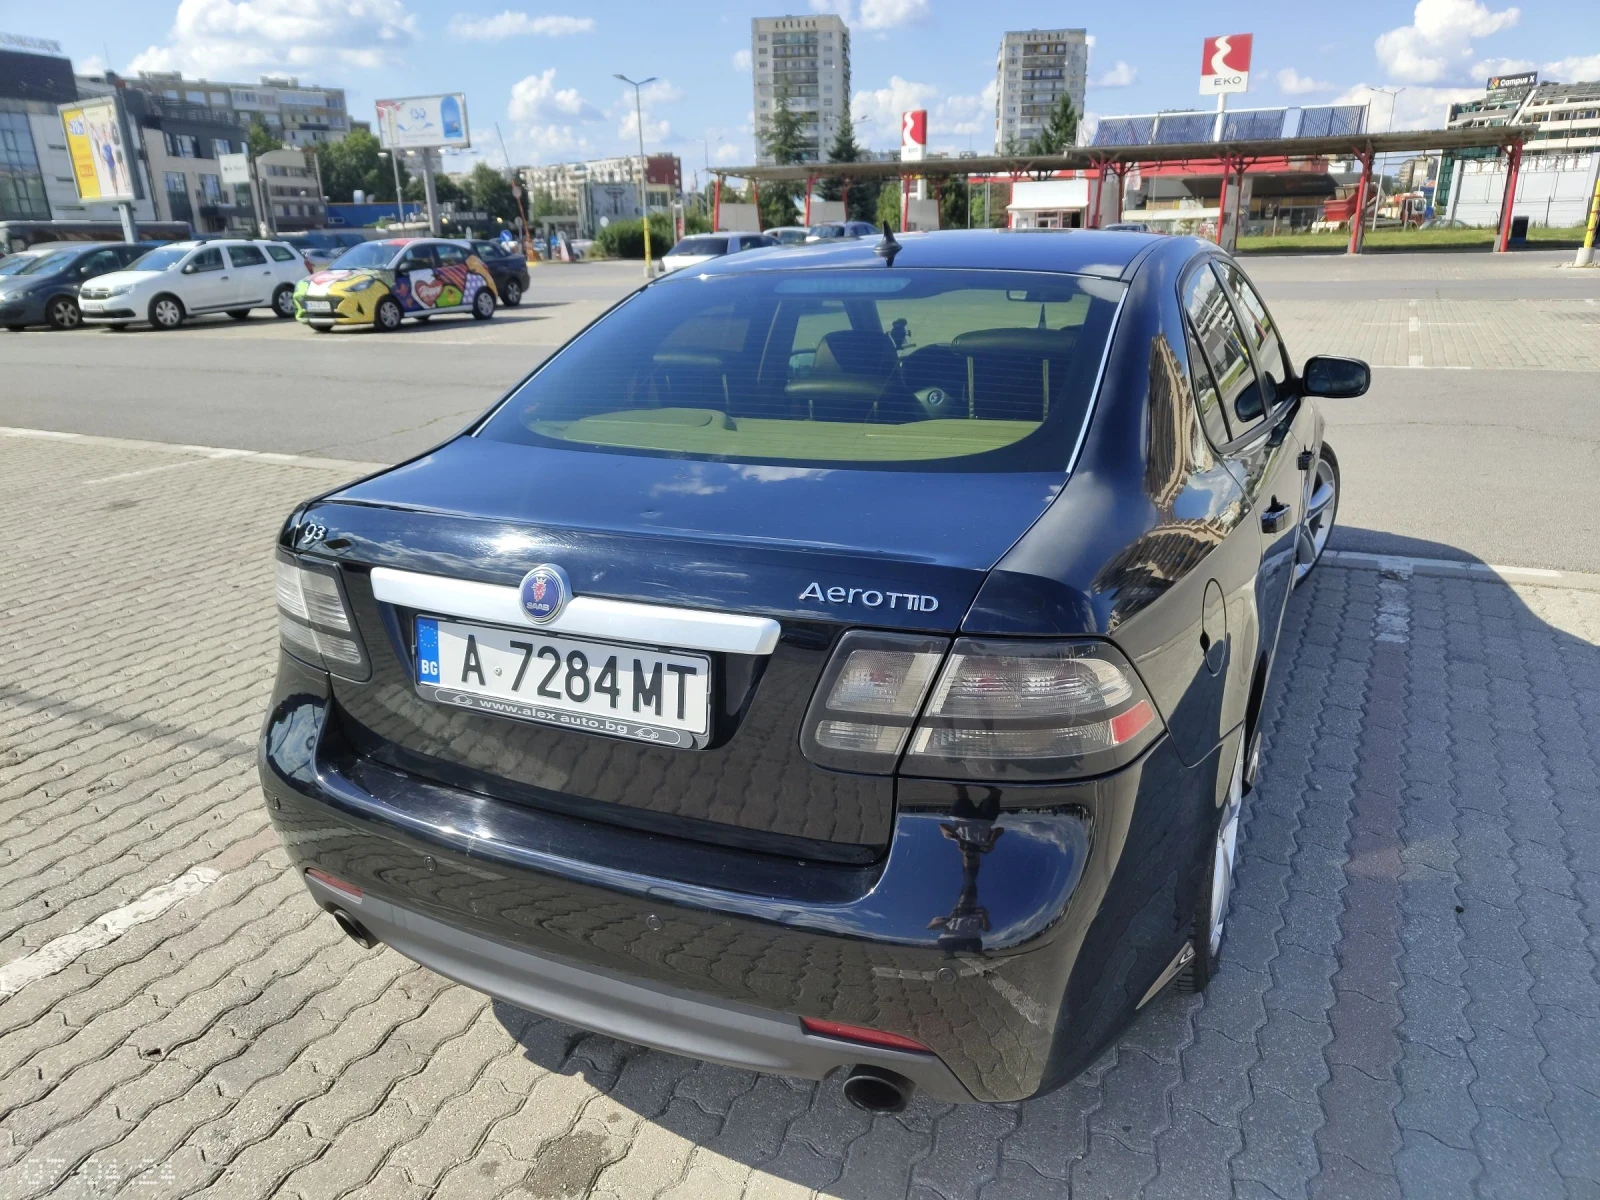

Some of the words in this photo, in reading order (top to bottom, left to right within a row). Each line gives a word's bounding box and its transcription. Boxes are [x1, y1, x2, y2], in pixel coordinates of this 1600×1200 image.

[1213, 75, 1242, 86] EKO
[1500, 77, 1529, 87] Campus
[1529, 75, 1535, 83] X
[302, 523, 327, 544] 93
[526, 601, 550, 612] SAAB
[421, 659, 438, 676] BG
[461, 634, 486, 686] A
[560, 715, 628, 734] auto.bg
